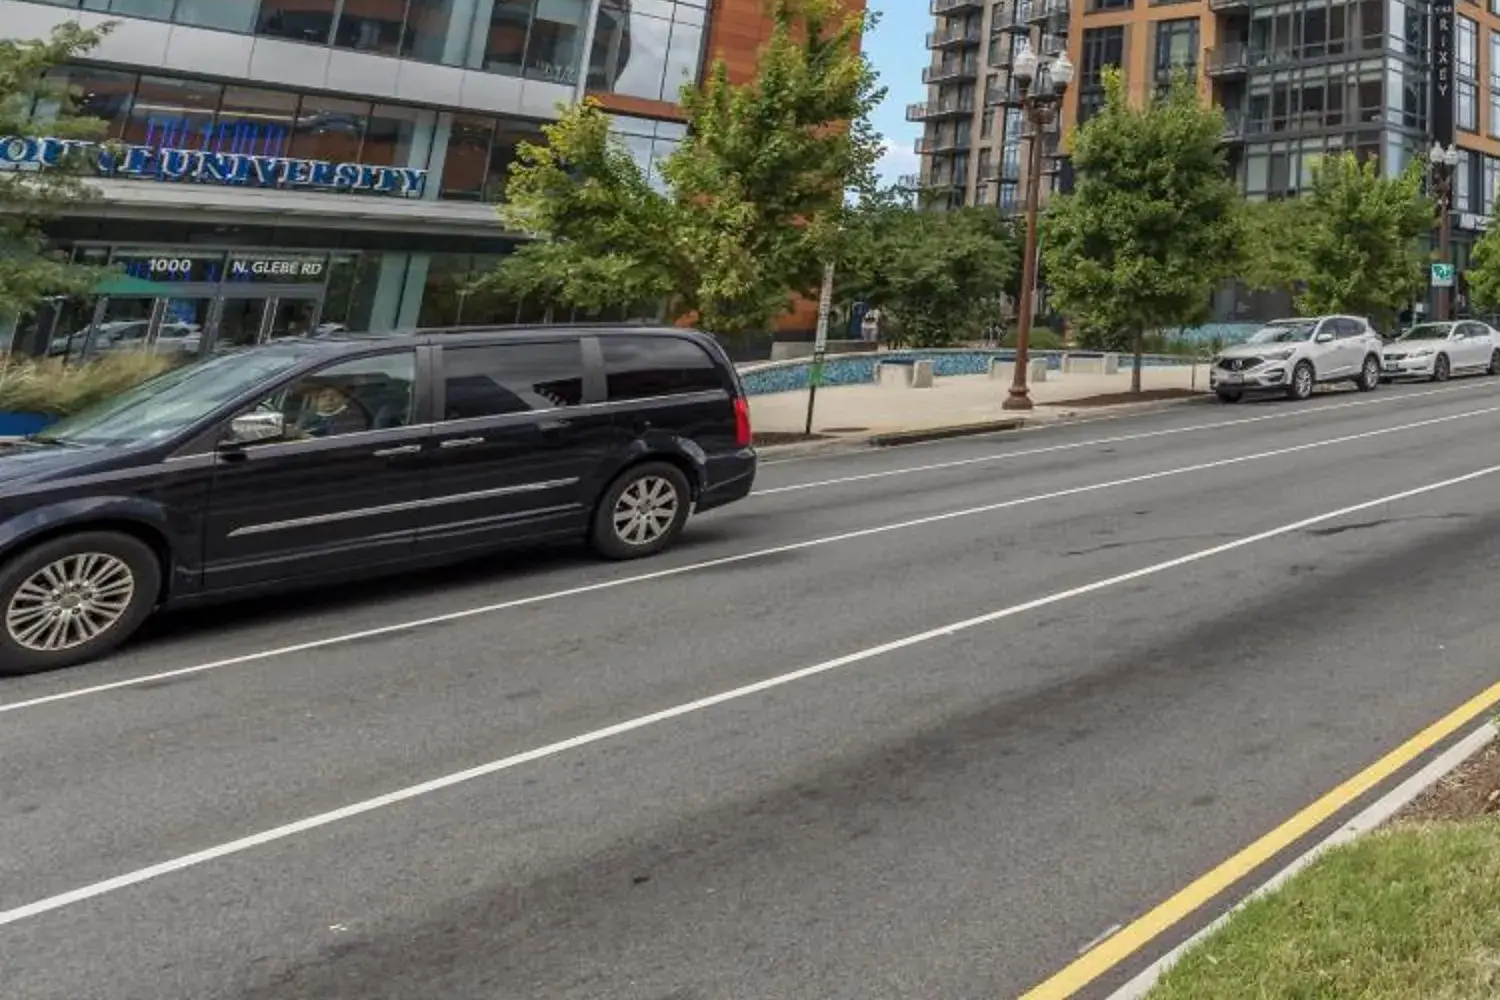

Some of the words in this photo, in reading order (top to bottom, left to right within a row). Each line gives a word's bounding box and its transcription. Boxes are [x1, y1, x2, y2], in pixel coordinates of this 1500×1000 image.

[1438, 17, 1449, 97] RIXEY
[161, 148, 430, 196] UNIVERSITY
[148, 259, 192, 273] 1000
[232, 260, 249, 273] N.
[251, 259, 297, 274] GLEBE
[301, 261, 323, 275] RD
